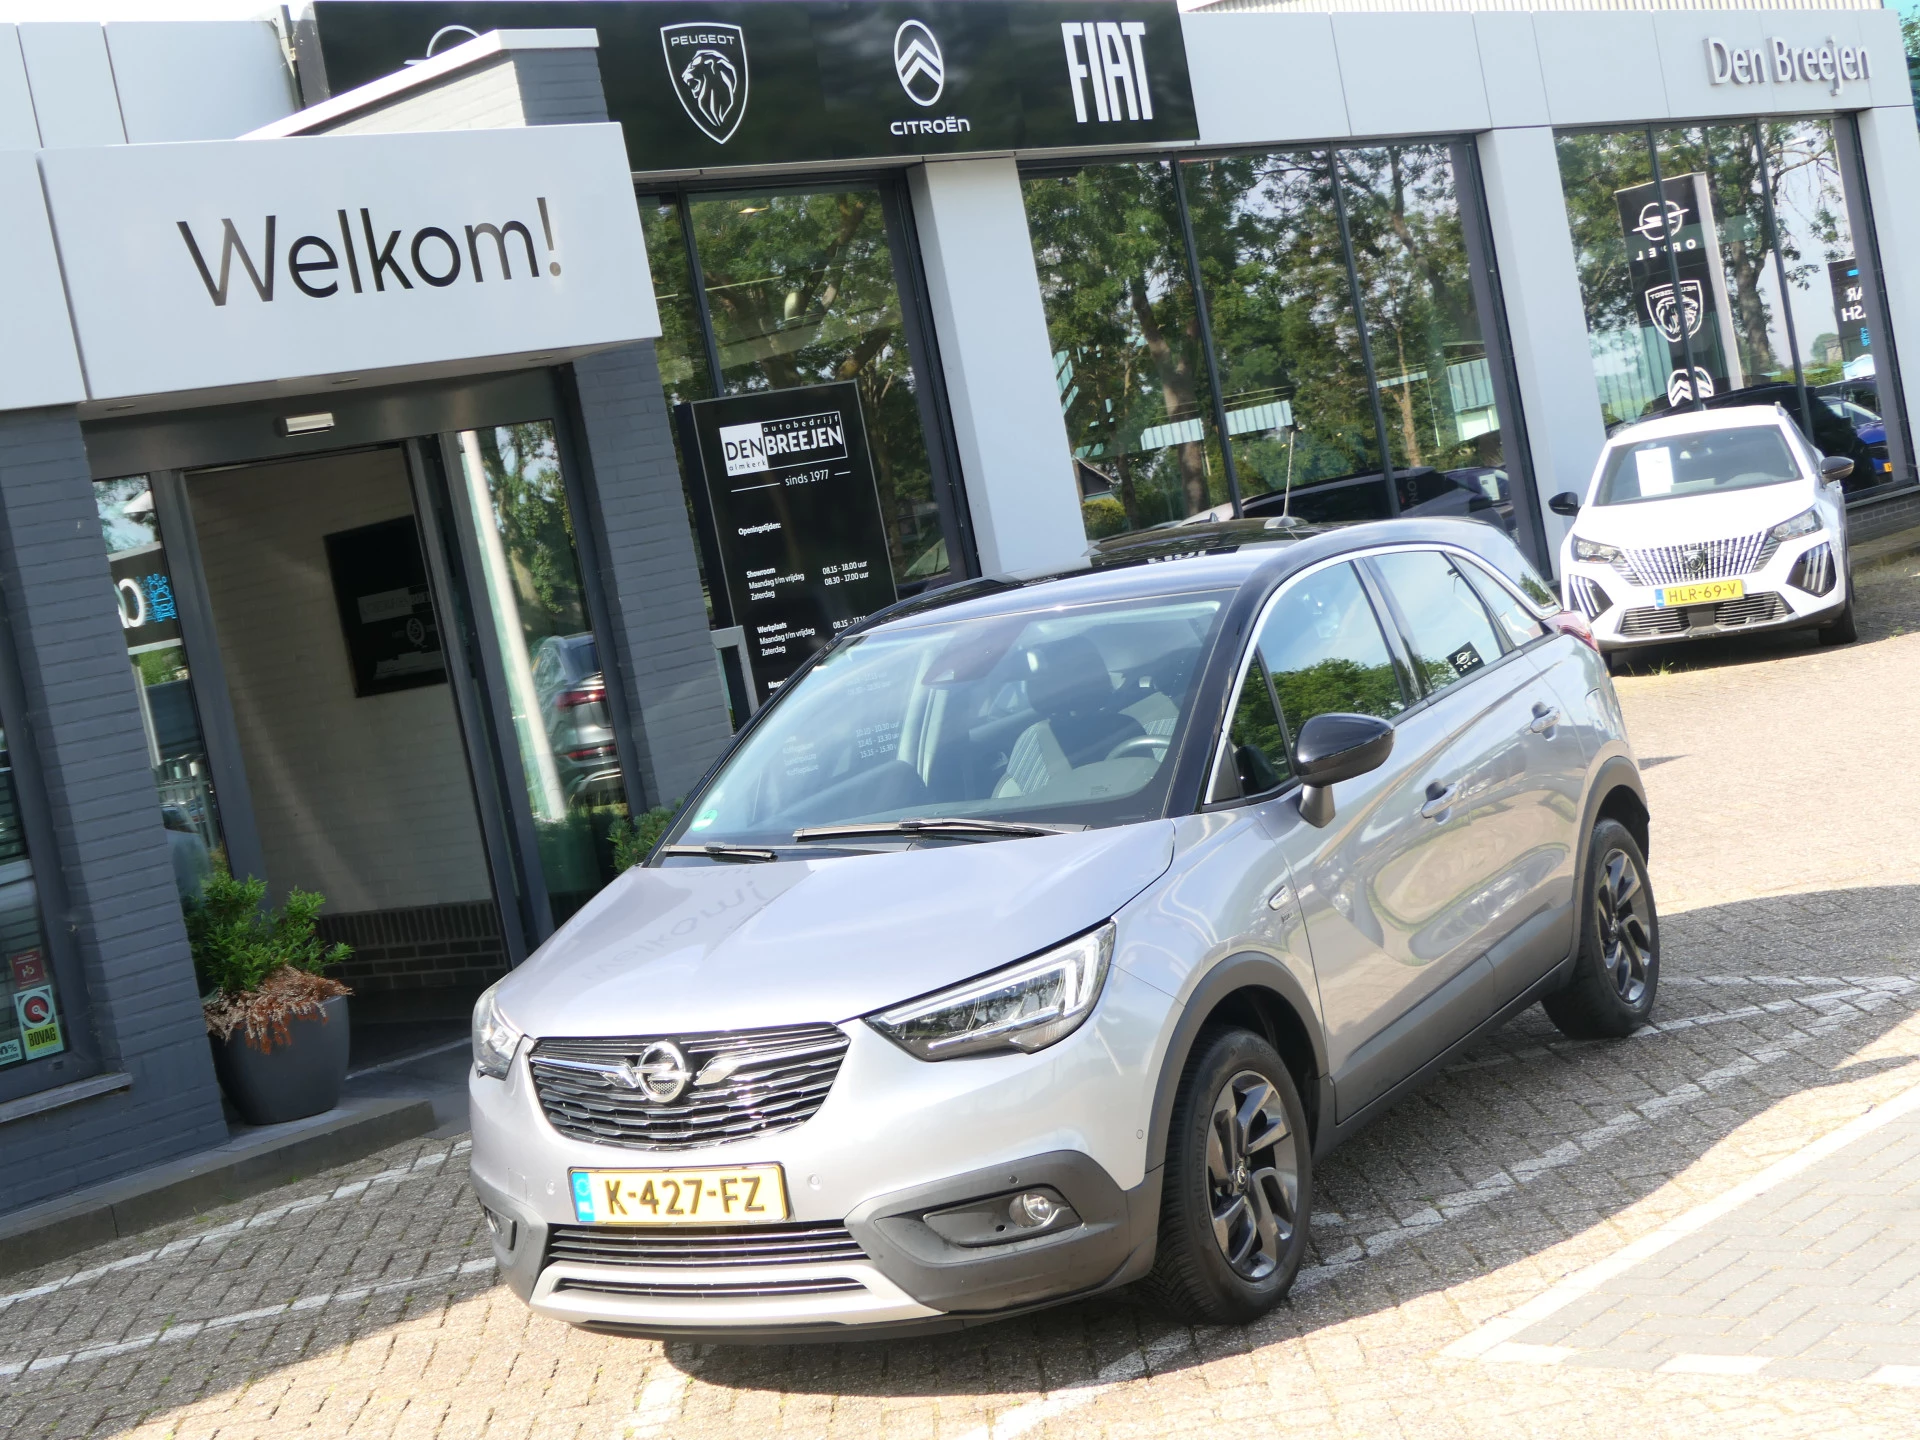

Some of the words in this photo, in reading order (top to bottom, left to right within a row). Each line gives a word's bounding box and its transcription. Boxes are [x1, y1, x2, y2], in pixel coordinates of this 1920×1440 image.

[670, 34, 735, 47] PEUGEOT
[1061, 22, 1153, 123] FIAT
[1702, 37, 1768, 86] Den
[1766, 34, 1871, 96] Breejen
[175, 196, 562, 307] Welkom!
[763, 414, 839, 432] autobedrijf
[724, 437, 765, 461] DEN
[764, 425, 843, 456] BREEJEN
[728, 460, 767, 471] almkerk
[785, 473, 808, 486] sinds
[809, 469, 829, 482] 1977
[738, 522, 781, 536] Openingstijden:
[857, 560, 868, 568] uur
[746, 567, 776, 579] Showroom
[748, 579, 775, 590] Maandag
[785, 572, 805, 583] vrijdag
[859, 571, 869, 579] uur
[750, 590, 776, 601] Zaterdag
[1668, 582, 1736, 603] HLR-69-V
[757, 621, 787, 634] Werkplaats
[759, 634, 785, 645] Maandag
[796, 627, 816, 638] vrijdag
[761, 645, 786, 657] Zaterdag
[28, 1027, 56, 1047] BOVAG
[604, 1175, 765, 1215] K-427-FZ
